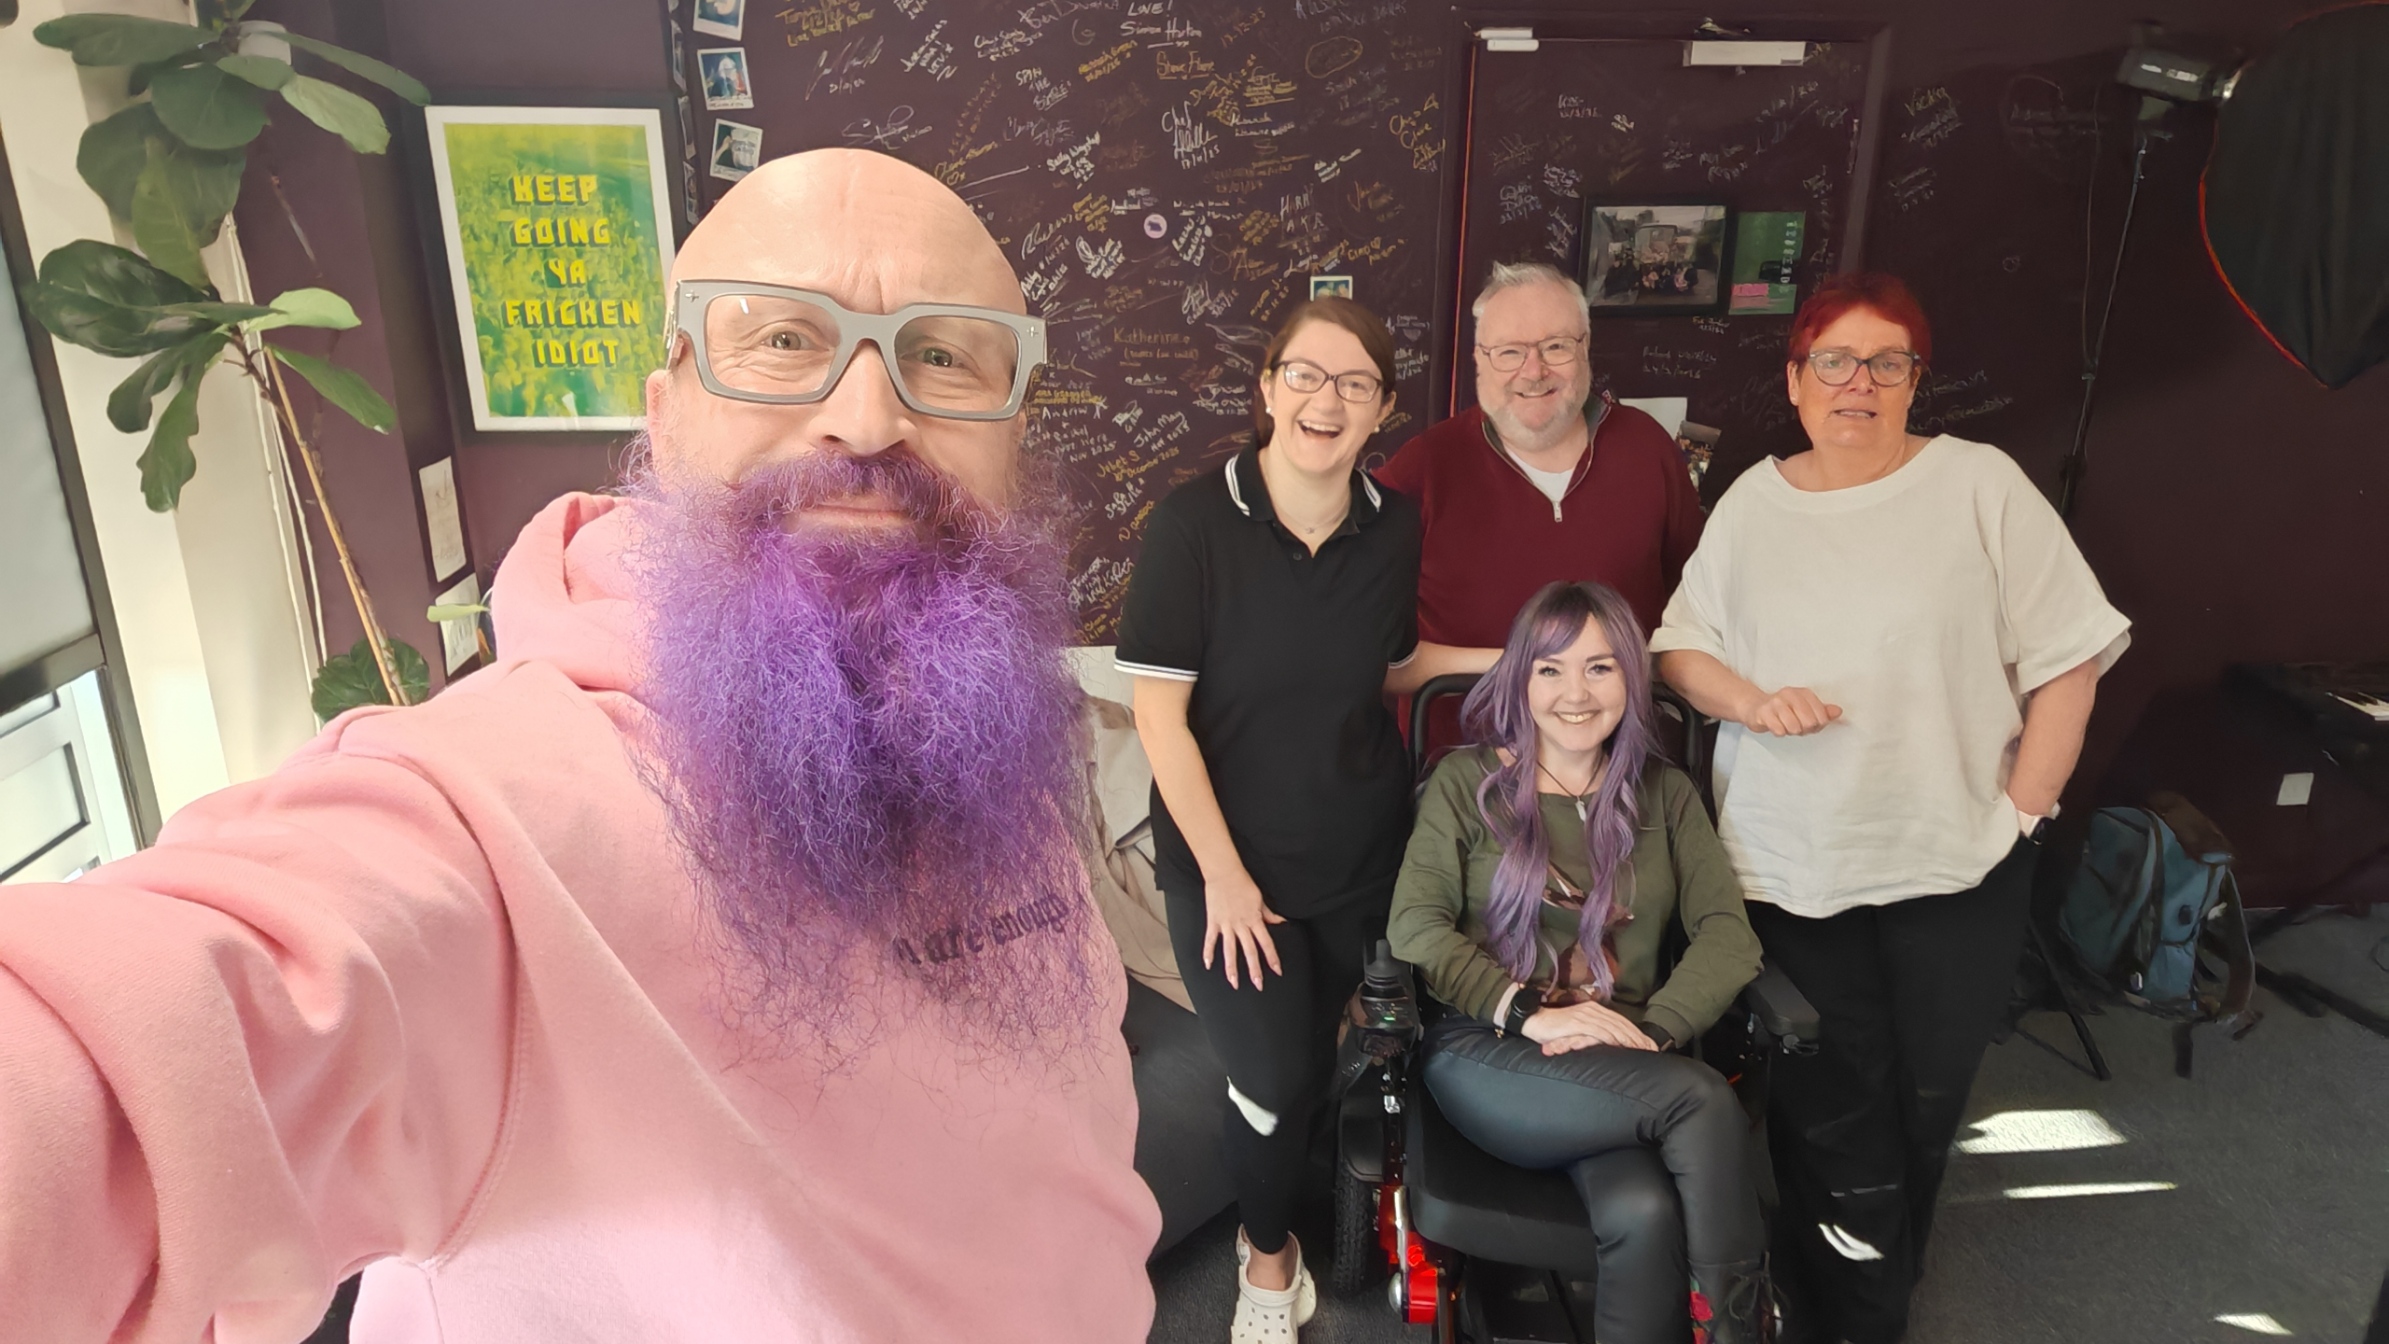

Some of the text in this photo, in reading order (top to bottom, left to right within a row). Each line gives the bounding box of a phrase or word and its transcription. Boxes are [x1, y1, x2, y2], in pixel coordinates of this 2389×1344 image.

[510, 174, 598, 203] KEEP
[512, 217, 610, 247] GOING
[547, 259, 587, 287] YA
[504, 300, 642, 328] FRICKEN
[536, 340, 620, 367] IDIOT
